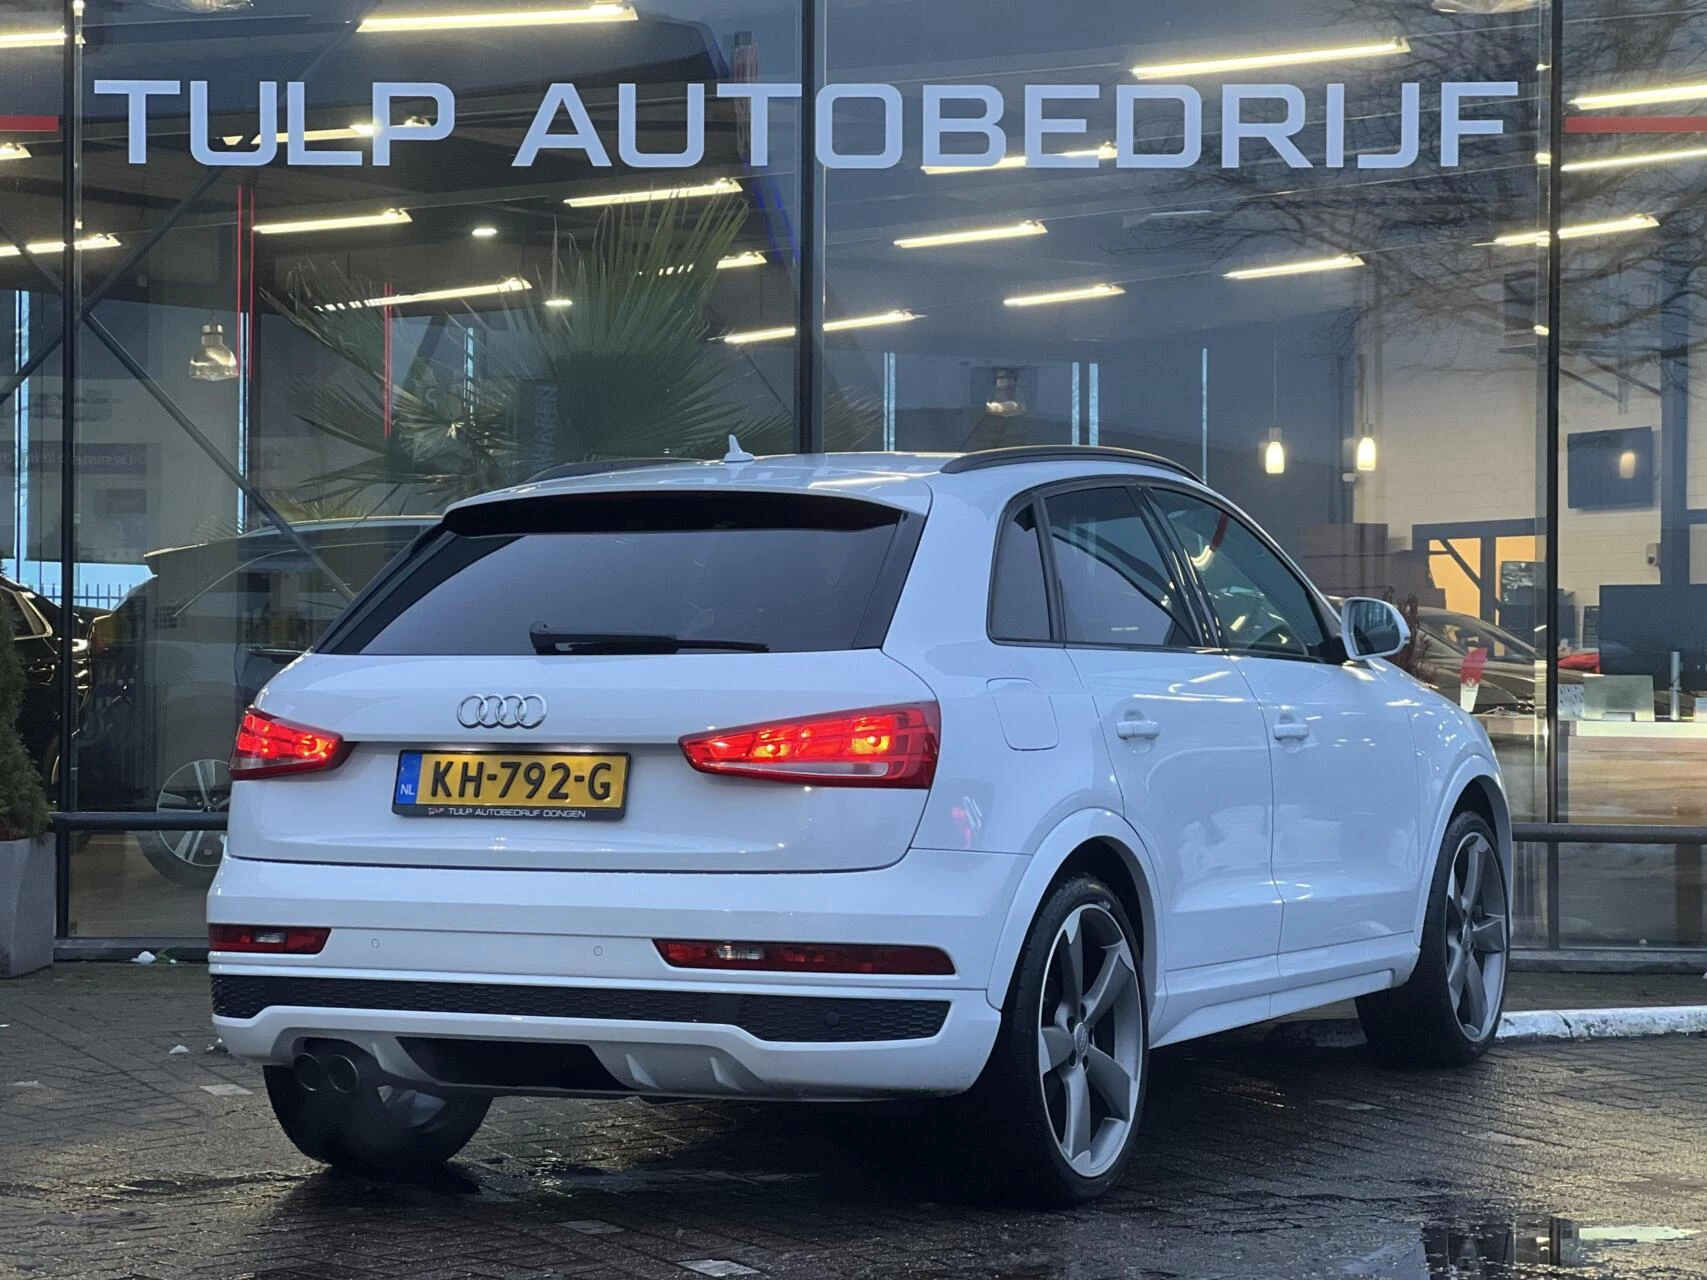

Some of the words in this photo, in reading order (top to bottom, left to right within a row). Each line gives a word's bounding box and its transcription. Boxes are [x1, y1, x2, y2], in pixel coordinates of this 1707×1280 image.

[94, 79, 455, 167] TULP
[513, 82, 1519, 169] AUTOBEDRIJF
[400, 784, 415, 796] NL
[430, 761, 611, 800] KH-792-G
[448, 807, 473, 815] TULP
[474, 808, 540, 817] AUTOBEDRIJF
[543, 809, 586, 818] DONGEN
